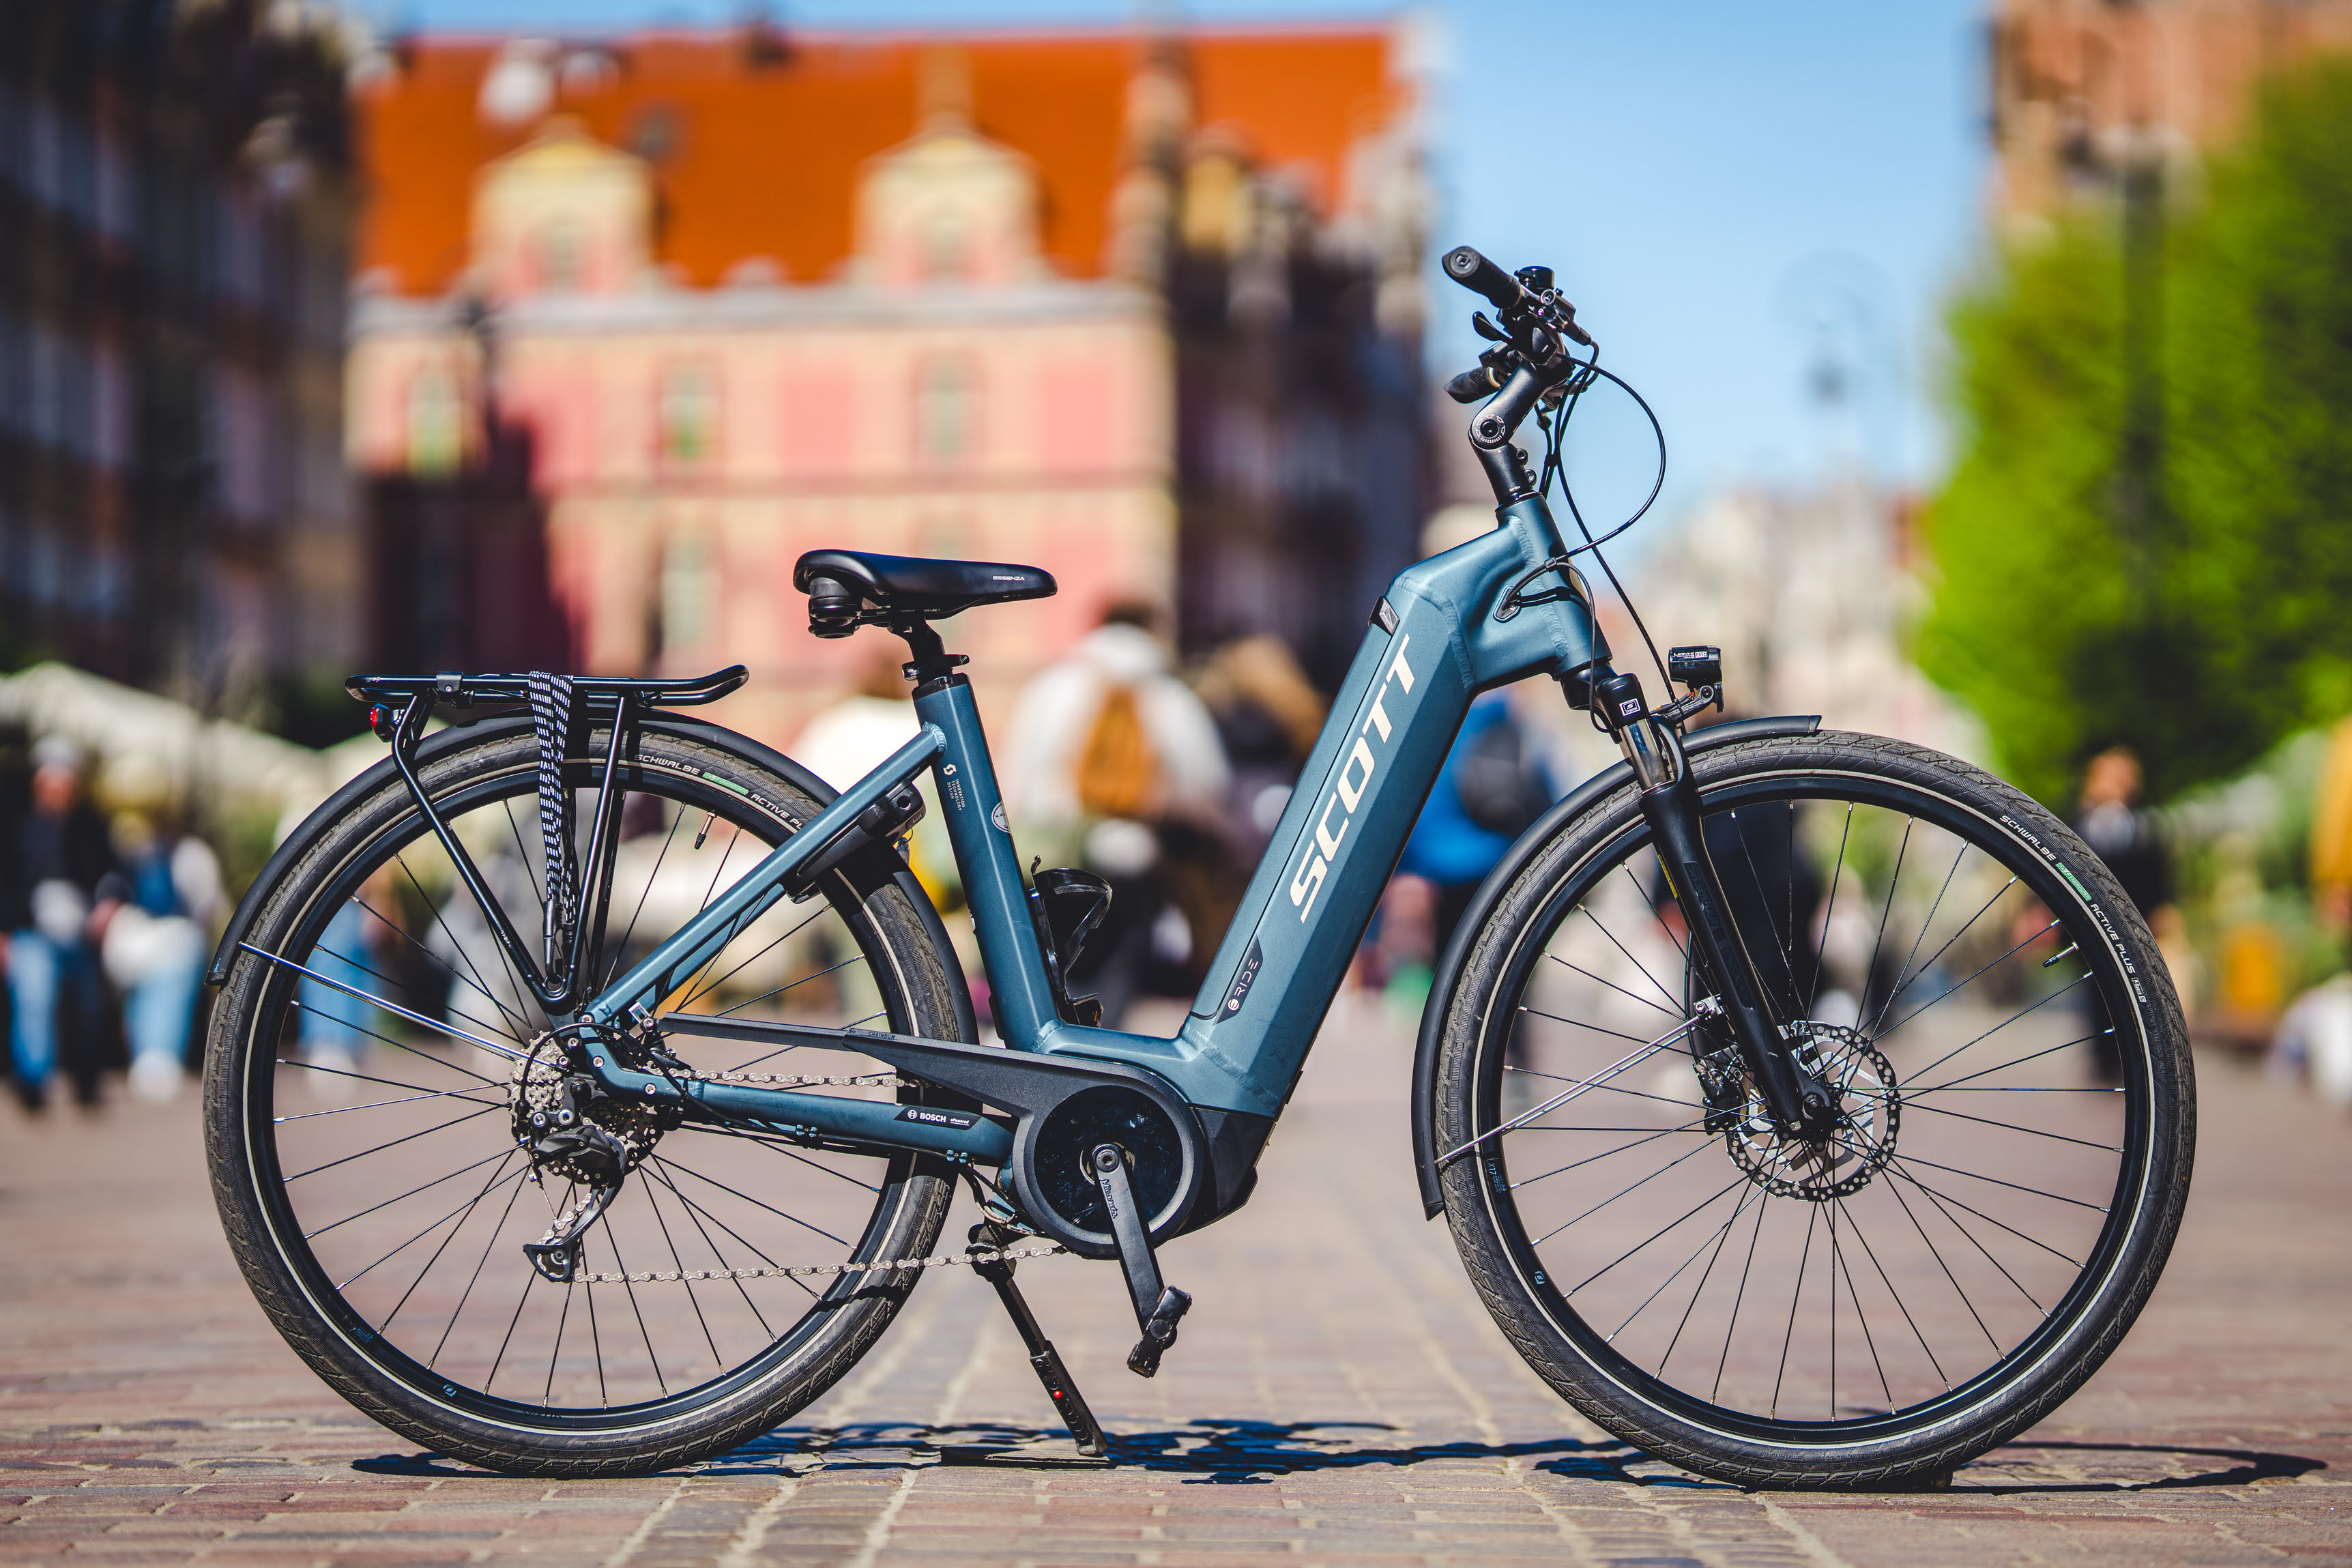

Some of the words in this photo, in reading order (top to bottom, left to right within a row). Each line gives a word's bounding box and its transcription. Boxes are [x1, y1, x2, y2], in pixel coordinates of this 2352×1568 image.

[634, 754, 700, 775] SCHWALBE
[751, 794, 790, 819] ACTIVE
[789, 818, 804, 830] PL
[955, 779, 966, 807] INNOVATION
[1290, 633, 1415, 924] SCOTT
[951, 781, 962, 811] TECHNOLOGY
[1999, 815, 2057, 861] SCHWALBE
[2091, 903, 2119, 940] ACTIVE
[2116, 943, 2136, 974] PLUS
[868, 1031, 896, 1040] CHAINBOW
[920, 1112, 946, 1122] BOSCH
[1488, 1163, 1497, 1175] X17
[1101, 1178, 1118, 1219] Miranda
